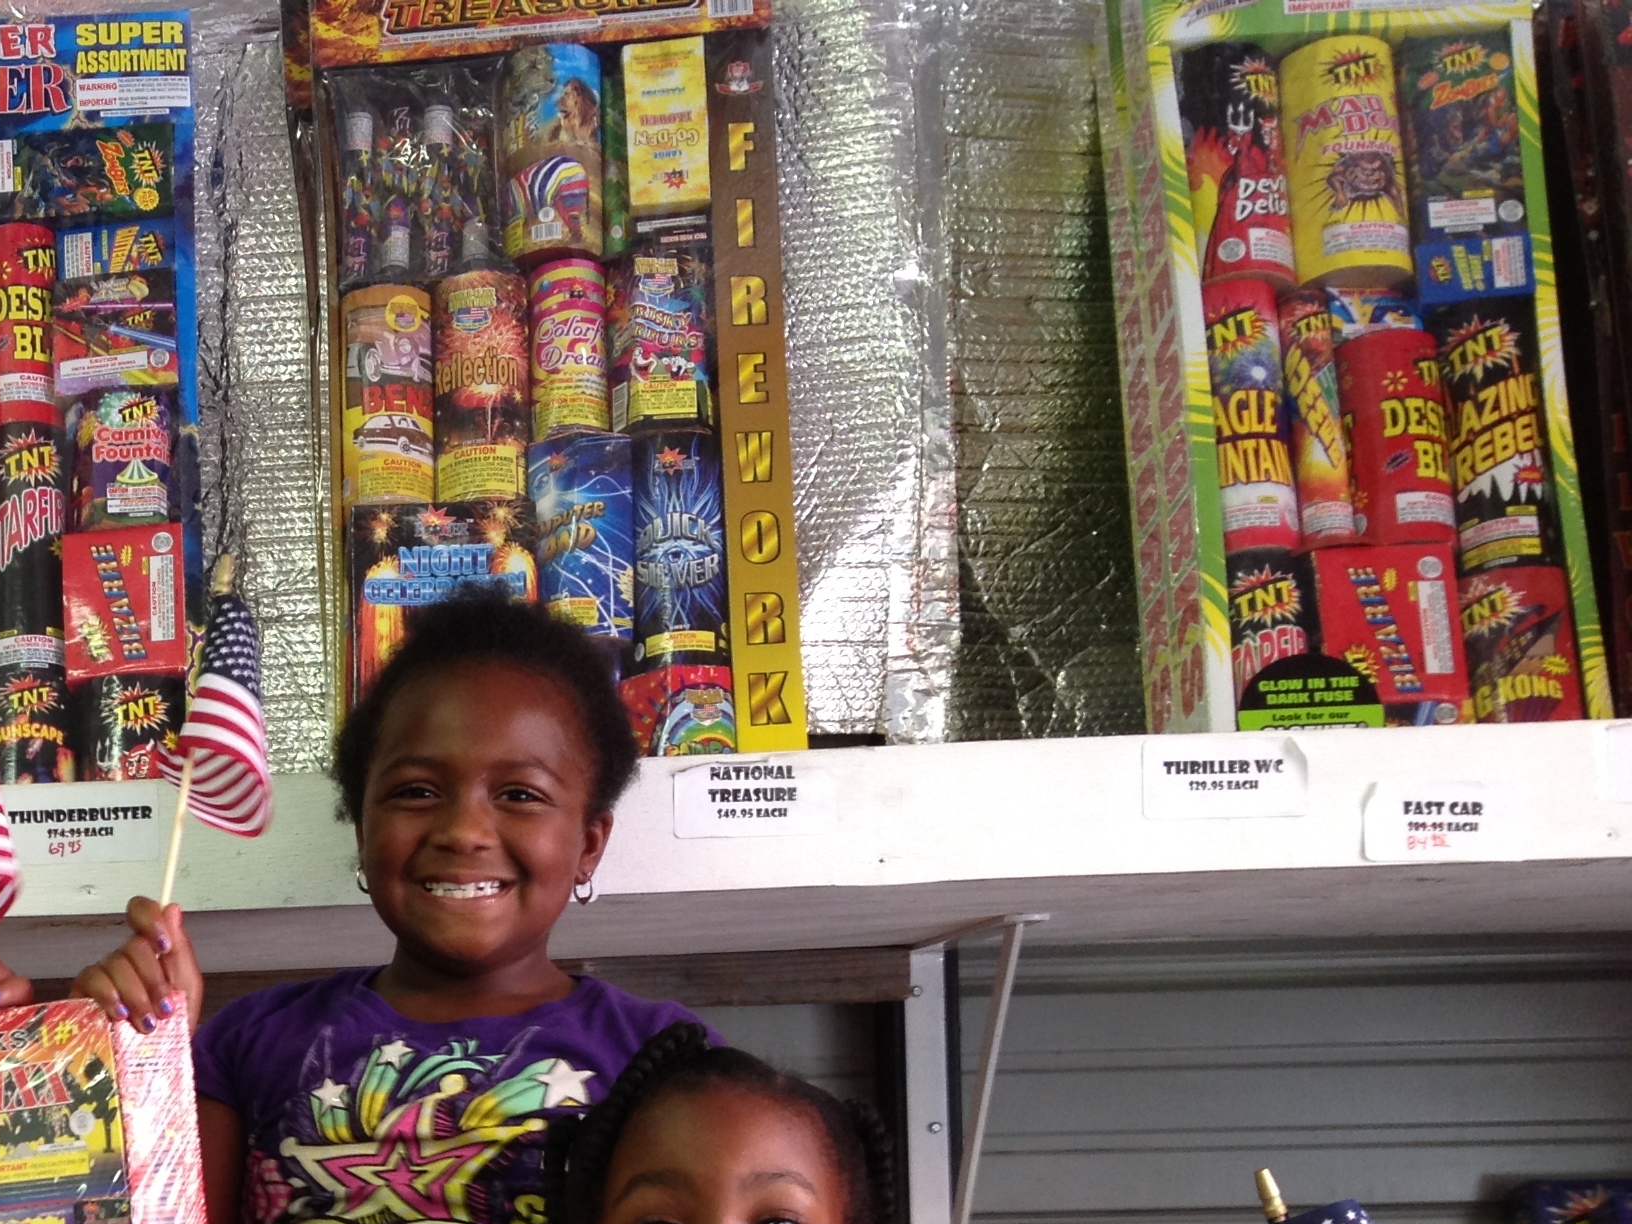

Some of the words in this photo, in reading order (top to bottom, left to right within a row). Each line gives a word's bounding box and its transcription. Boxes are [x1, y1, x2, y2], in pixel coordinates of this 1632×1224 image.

[76, 21, 184, 46] SUPER
[76, 48, 187, 74] ASSORTMENT
[1442, 48, 1478, 71] TNT
[1333, 58, 1377, 84] TNT
[79, 82, 118, 92] WARNING
[79, 97, 118, 107] IMPORTANT
[634, 128, 700, 146] GOLDEN
[1296, 93, 1385, 164] MAD
[1207, 309, 1257, 349] NT
[1449, 325, 1504, 374] TNT
[435, 347, 518, 395] Reflection
[121, 400, 154, 423] TNT
[4, 444, 54, 478] TNT
[453, 446, 497, 460] CAUTION
[383, 459, 422, 469] CAUTION
[639, 511, 717, 551] QUICK
[398, 543, 494, 577] NIGHT
[90, 544, 148, 660] BIZARRE
[1233, 580, 1294, 619] TNT
[1258, 679, 1303, 692] GLOW
[1307, 677, 1326, 690] IN
[1329, 676, 1360, 689] THE
[1497, 673, 1565, 703] KONG
[10, 687, 53, 712] TNT
[1267, 692, 1310, 705] DARK
[1317, 690, 1354, 703] FUSE
[113, 698, 161, 726] TNT
[1272, 712, 1300, 722] Look
[1306, 711, 1324, 721] for
[709, 765, 795, 781] NATIONAL
[1163, 758, 1251, 775] THRILLER
[708, 787, 798, 803] TREASURE
[1188, 780, 1224, 791] $29.95
[1226, 779, 1259, 790] EACH
[8, 805, 153, 824] THUNDERBUSTER
[716, 808, 754, 819] $49.95
[756, 807, 788, 818] EACH
[1402, 800, 1446, 816] FAST
[1448, 800, 1484, 816] CAR
[84, 826, 115, 837] EACH
[1446, 821, 1480, 832] EACH
